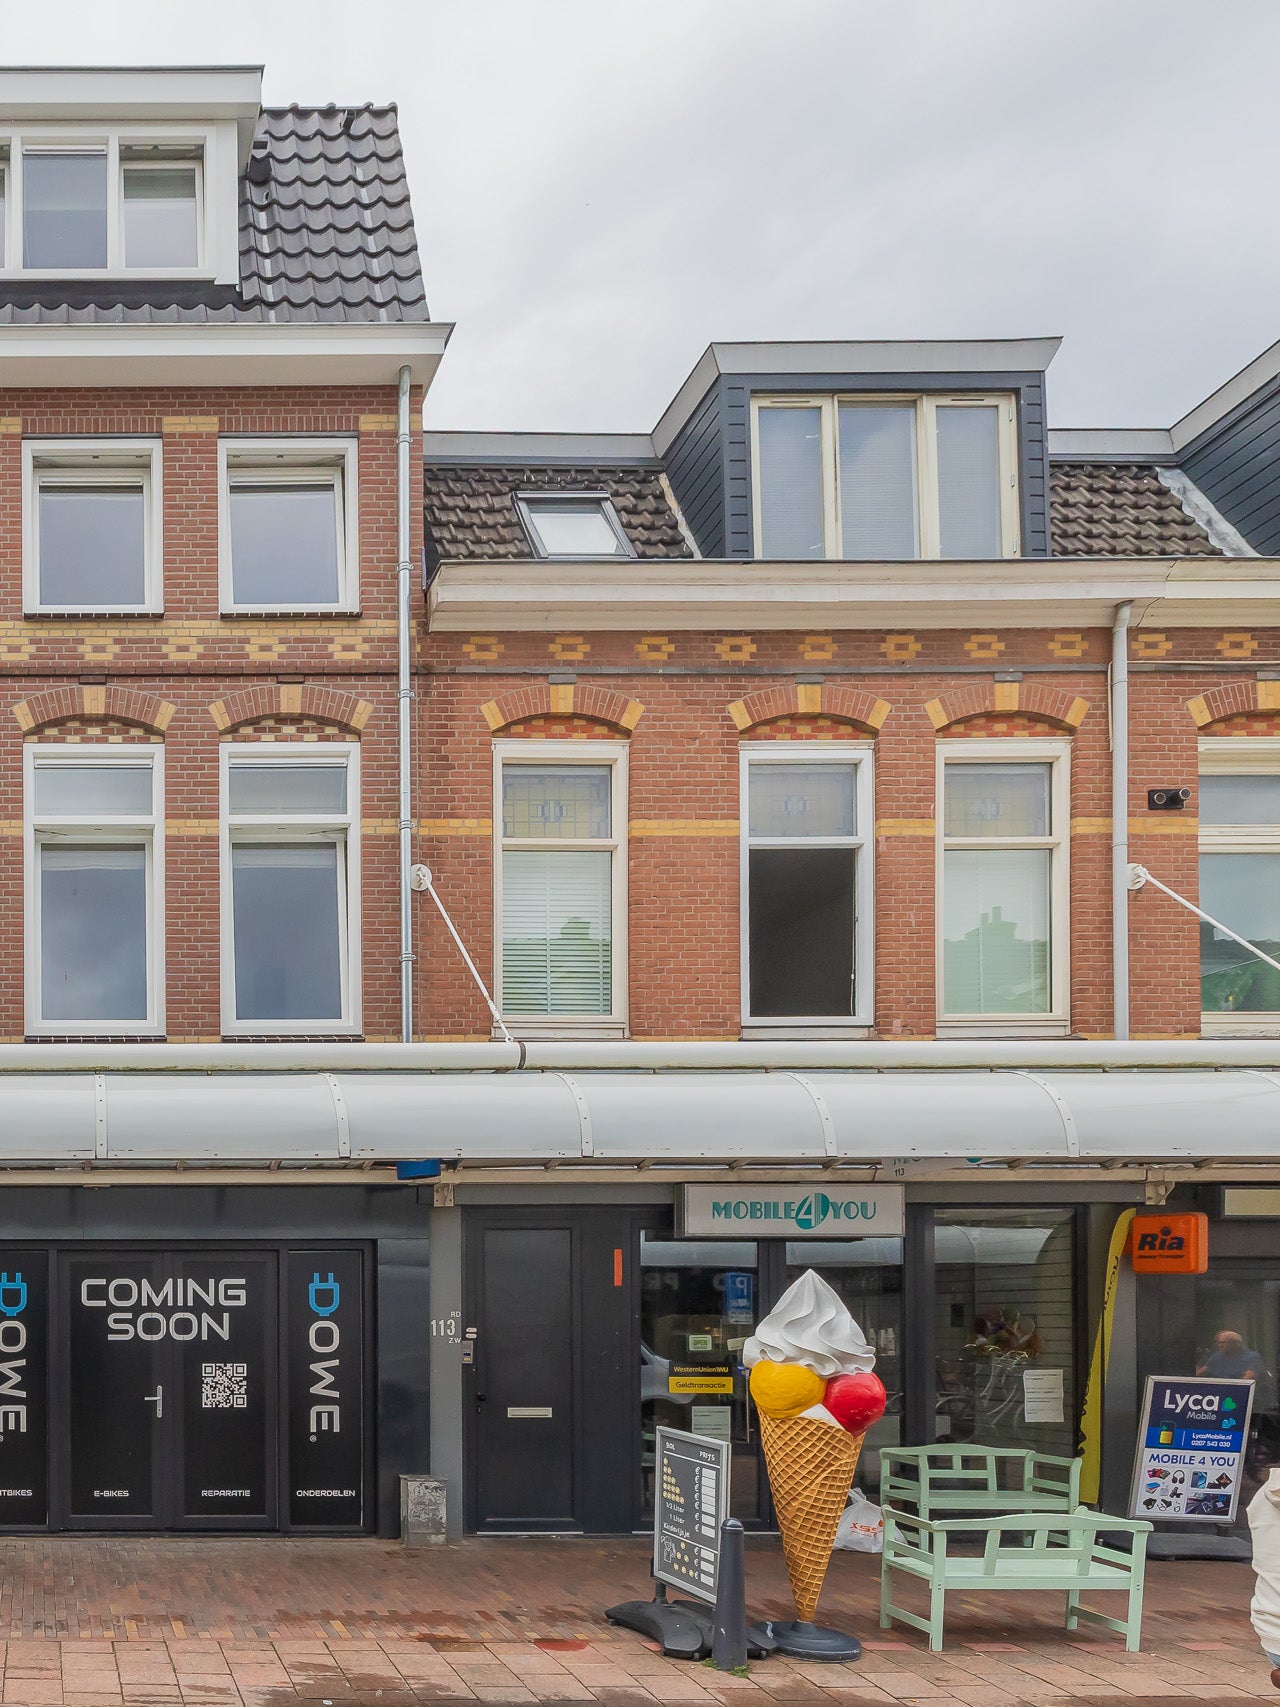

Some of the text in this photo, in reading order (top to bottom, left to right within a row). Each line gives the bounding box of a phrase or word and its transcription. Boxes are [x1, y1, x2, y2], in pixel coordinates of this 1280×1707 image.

[894, 1168, 905, 1177] 113
[1138, 1226, 1185, 1250] Ria
[81, 1278, 247, 1307] COMING
[107, 1312, 230, 1341] SOON
[430, 1319, 456, 1336] 113
[675, 1381, 727, 1389] Geldtransactie
[1163, 1389, 1220, 1413] Lyca
[1186, 1411, 1217, 1421] Mobile
[1192, 1432, 1232, 1440] LycaMobile.nl
[1148, 1453, 1236, 1467] MOBILE 4 YOU
